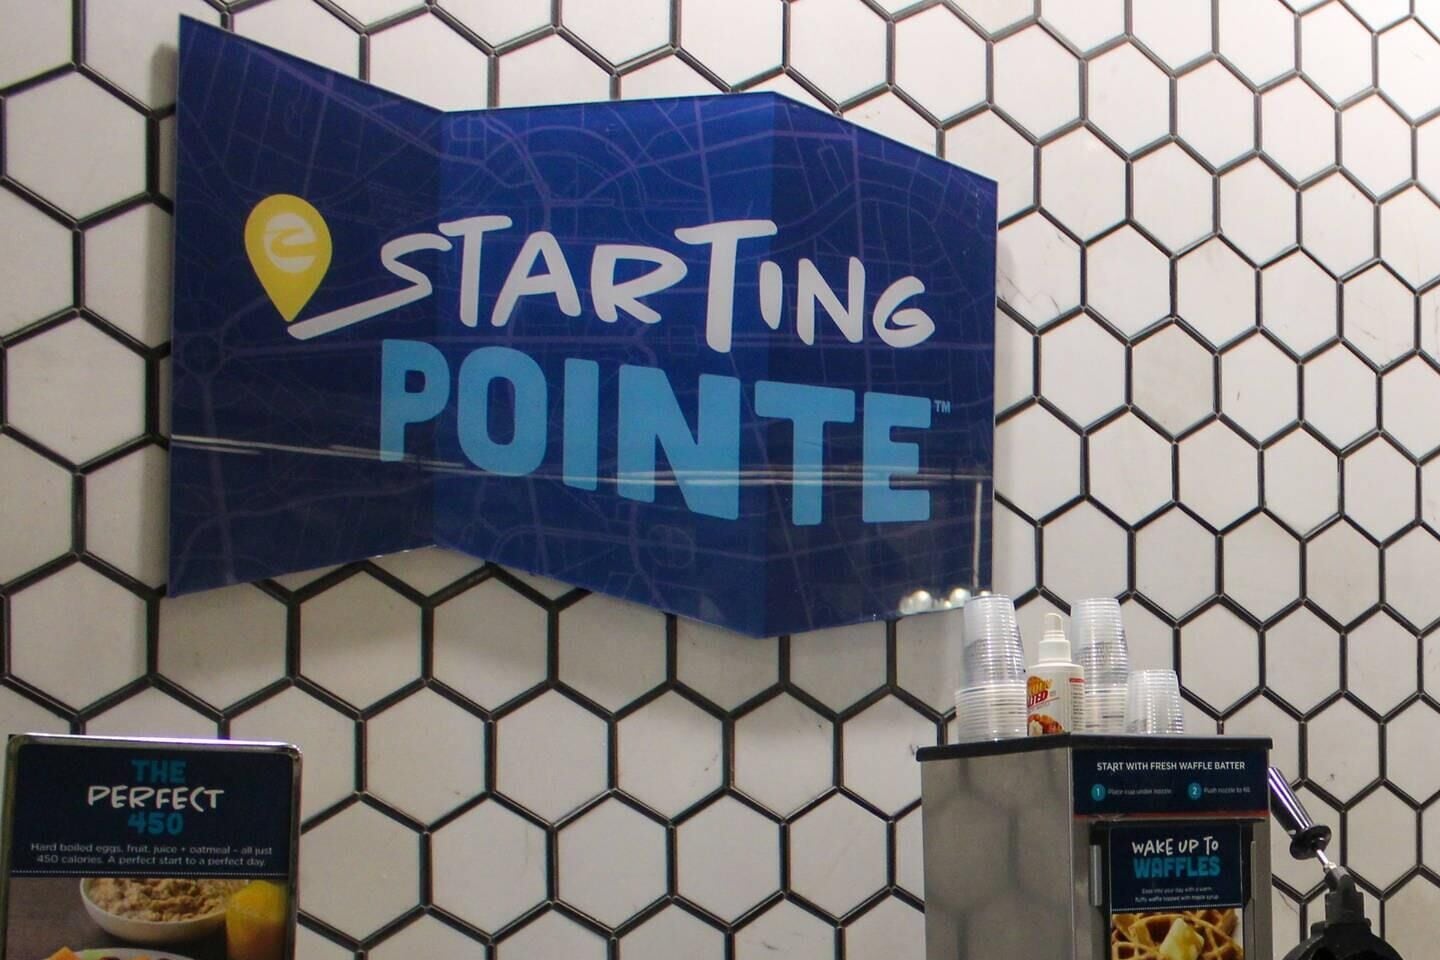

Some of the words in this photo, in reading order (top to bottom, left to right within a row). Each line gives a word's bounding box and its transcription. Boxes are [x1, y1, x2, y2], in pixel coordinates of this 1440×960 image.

[287, 214, 937, 353] STARTING
[379, 339, 932, 526] POINTE
[130, 758, 187, 784] THE
[1096, 762, 1124, 772] START
[1126, 762, 1149, 770] WITH
[1150, 762, 1177, 770] FRESH
[1179, 761, 1213, 770] WAFFLE
[1215, 761, 1246, 770] BATTER
[86, 785, 225, 812] PERFECT
[126, 812, 185, 836] 450
[30, 842, 57, 852] Hard
[59, 842, 93, 852] boiled
[152, 844, 178, 854] juice
[189, 845, 231, 855] oatmeal
[240, 846, 253, 855] all
[254, 846, 273, 856] just
[1131, 838, 1174, 856] WAKE
[1178, 839, 1200, 854] UP
[36, 854, 58, 863] 450
[60, 854, 102, 864] calories.
[107, 855, 116, 864] A
[118, 855, 156, 865] perfect
[159, 856, 183, 865] start
[185, 856, 196, 865] to
[207, 856, 244, 867] perfect
[1133, 856, 1221, 878] WAFFLES
